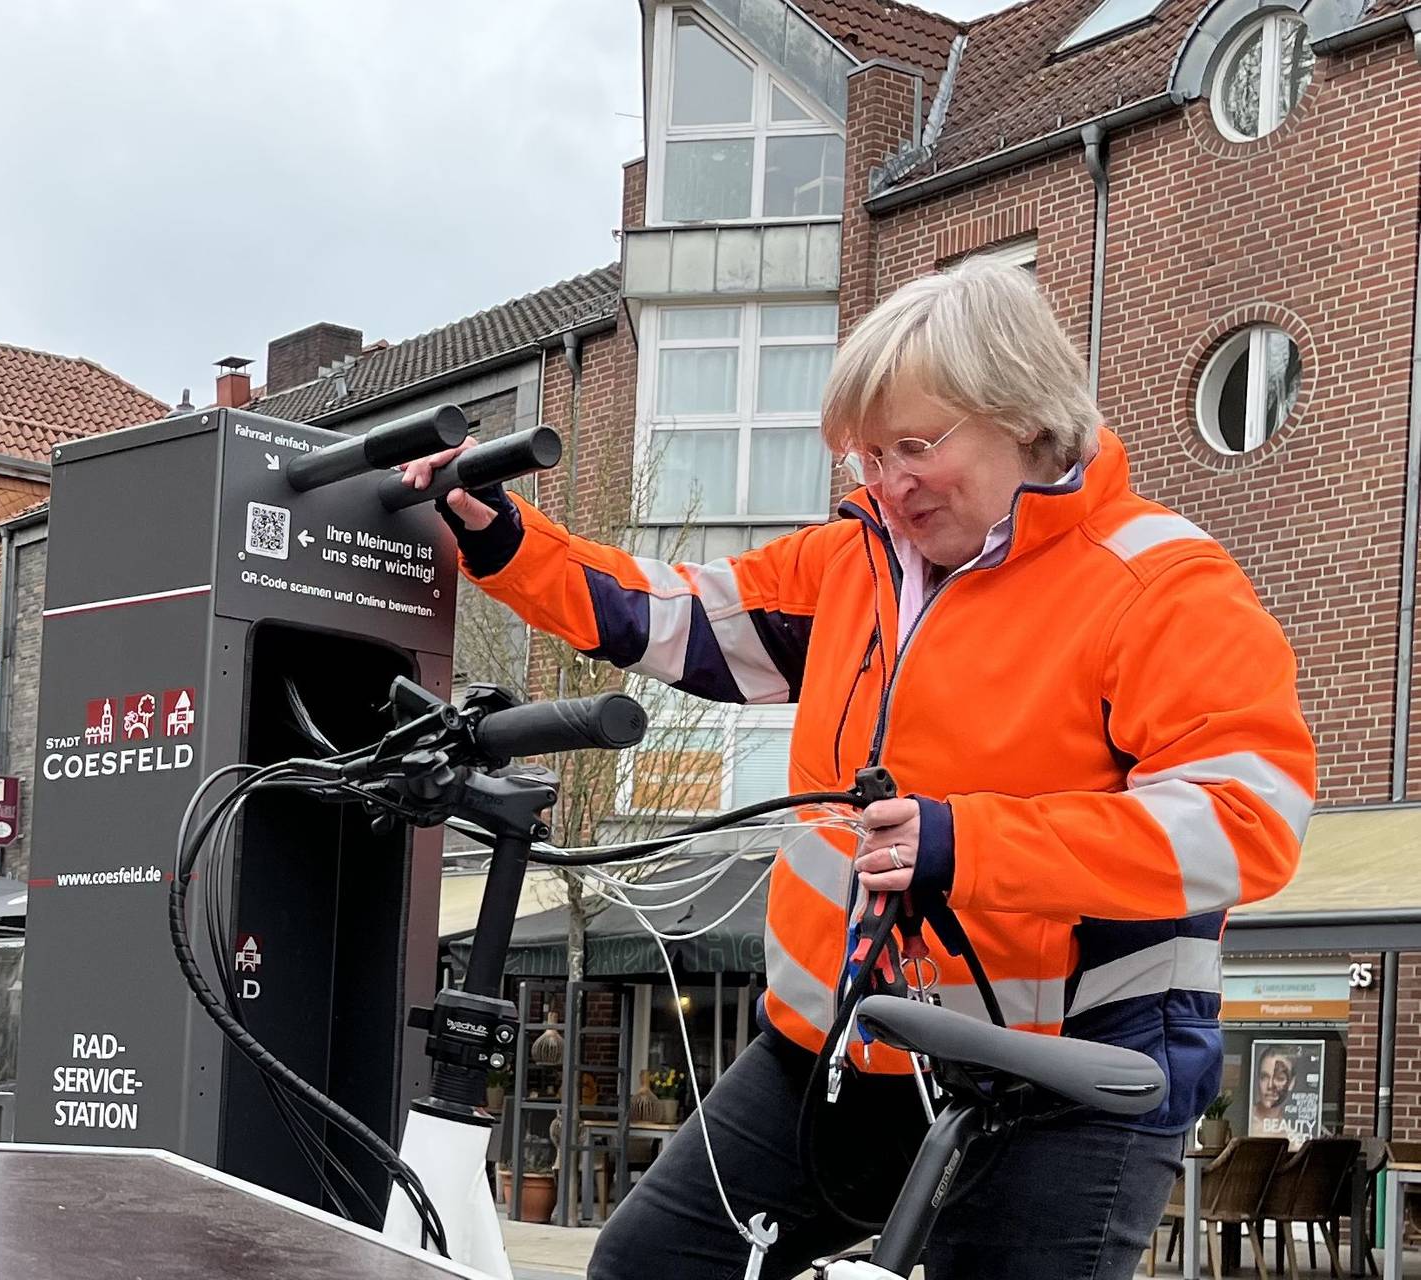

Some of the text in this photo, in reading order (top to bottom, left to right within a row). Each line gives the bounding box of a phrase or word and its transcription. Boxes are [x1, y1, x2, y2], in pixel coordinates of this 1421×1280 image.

[234, 424, 272, 442] Fahrrad
[274, 434, 310, 452] einfach
[326, 524, 433, 560] Ihre Meinung ist
[322, 548, 435, 583] uns sehr wichtig!
[241, 571, 436, 617] QR-Code scannen und Online bewerten.
[45, 736, 81, 749] STADT
[43, 744, 194, 781] COESFELD
[57, 865, 162, 886] www.coesfeld.de
[1348, 962, 1372, 987] 35
[72, 1033, 126, 1059] RAD-
[52, 1066, 143, 1095] SERVICE-
[54, 1100, 138, 1130] STATION
[1263, 1118, 1316, 1134] BEAUTY
